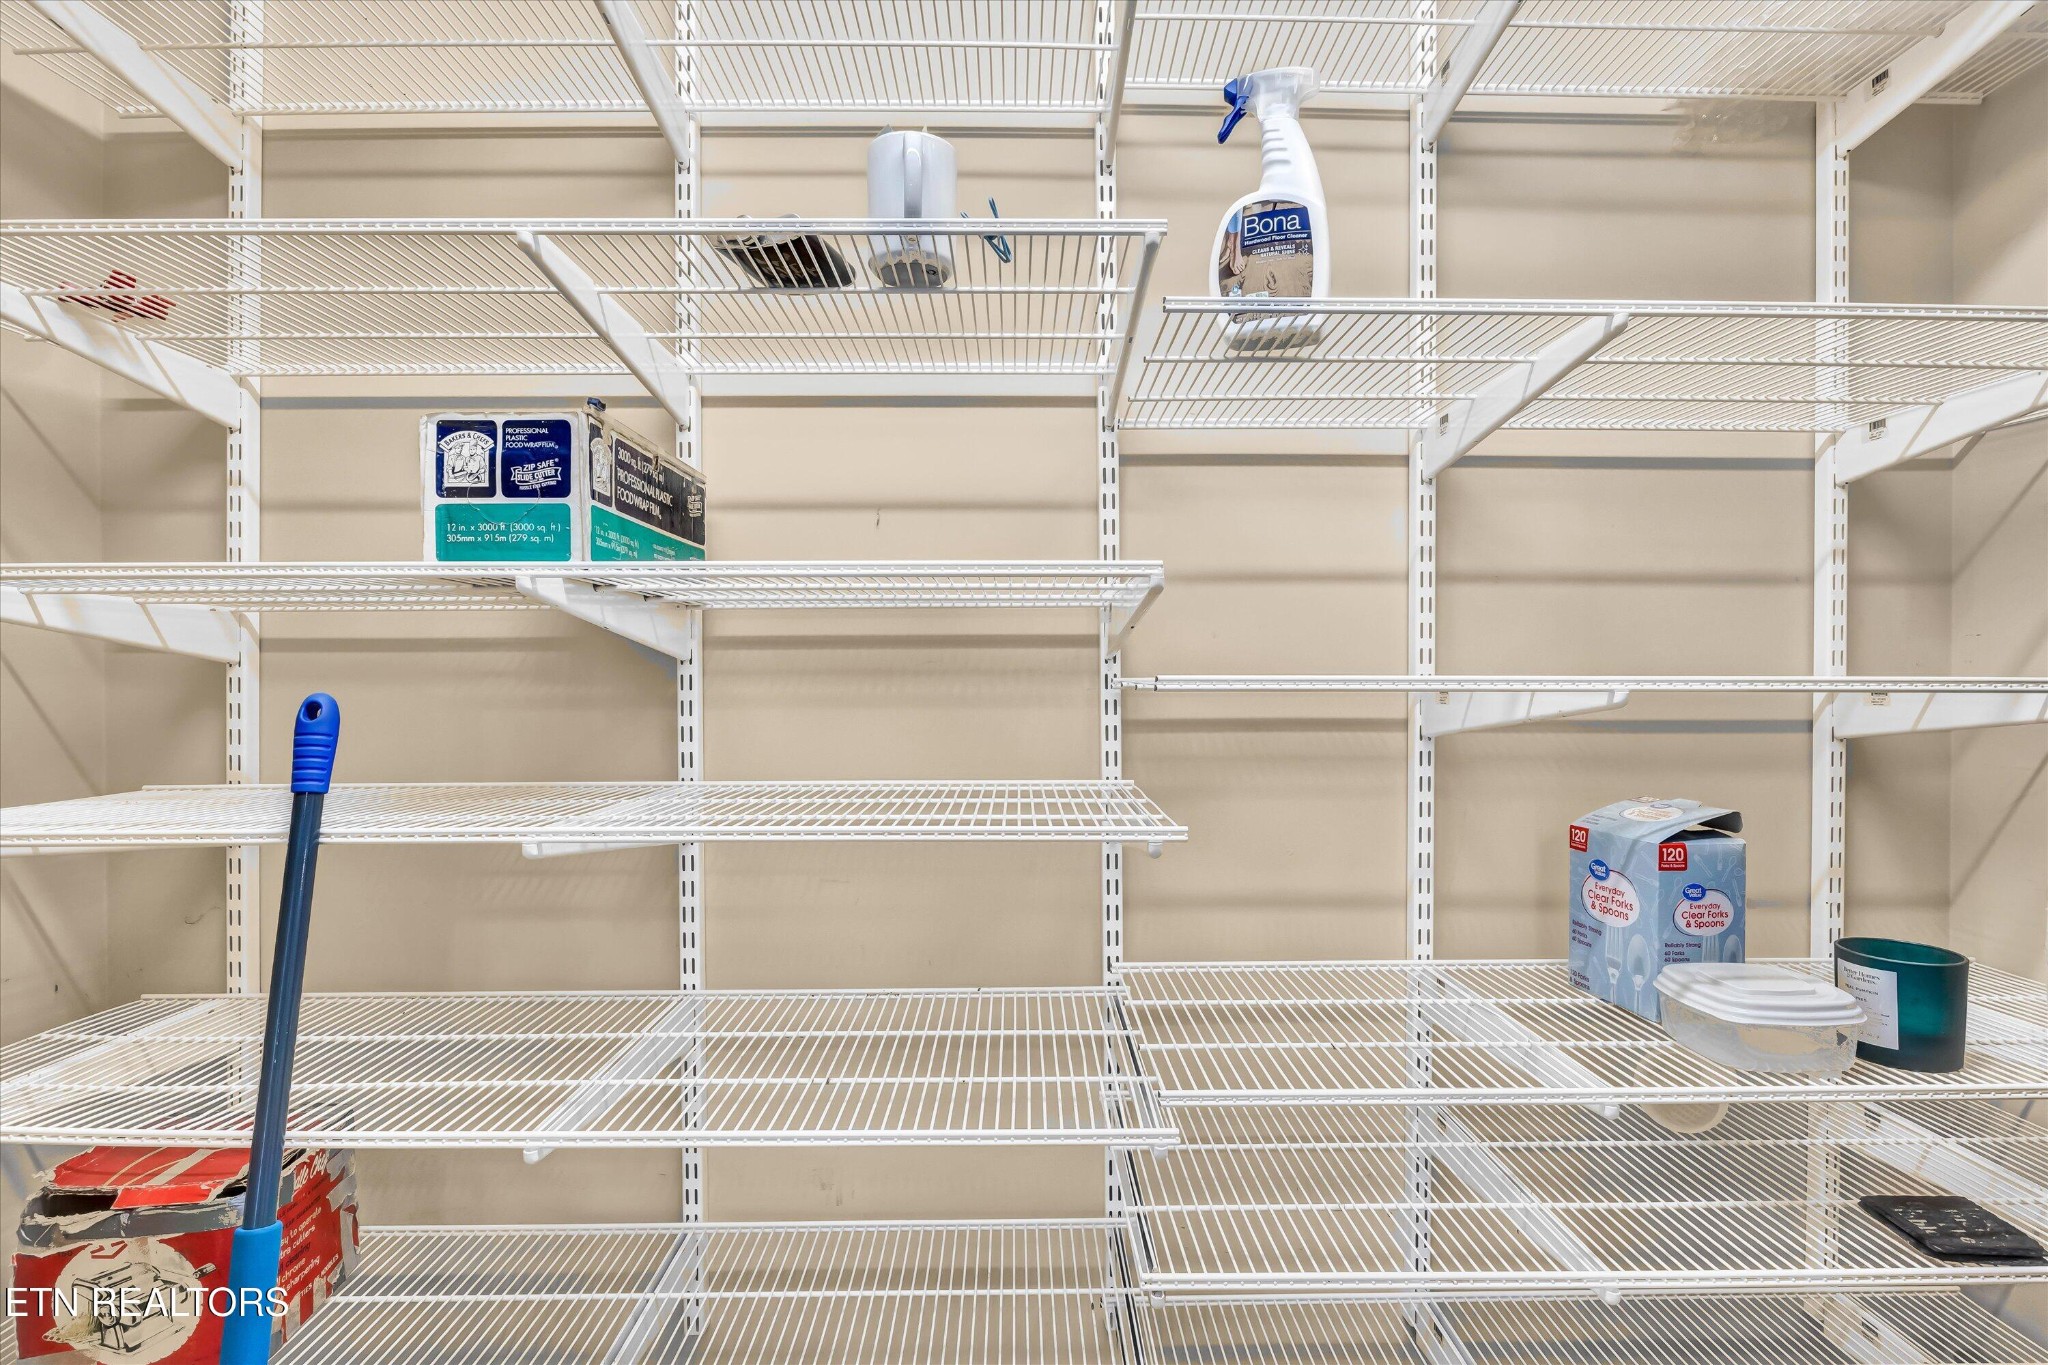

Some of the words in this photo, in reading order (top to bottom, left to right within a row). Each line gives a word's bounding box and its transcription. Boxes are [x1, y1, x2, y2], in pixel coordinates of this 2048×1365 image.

[1244, 214, 1302, 237] Bona
[1244, 236, 1272, 246] Hardwood
[1252, 247, 1270, 255] CLEANS
[444, 432, 466, 446] BAKERS
[617, 447, 631, 463] 3000
[523, 463, 535, 471] ZIP
[537, 460, 555, 469] SAFE
[534, 469, 555, 479] CUTTER
[616, 466, 656, 498] PROFESSIONAL
[655, 488, 673, 507] PLASTIC
[616, 486, 634, 505] FOOD
[634, 494, 649, 511] WRAP
[649, 502, 660, 517] FILM
[446, 524, 456, 532] 12
[458, 523, 468, 531] in.
[477, 523, 498, 531] 3000
[510, 523, 534, 533] (3000
[536, 525, 547, 533] sq.
[550, 522, 561, 532] ft.)
[446, 534, 474, 543] 305mm
[484, 534, 506, 542] 915m
[509, 533, 528, 543] (279
[544, 534, 554, 543] m)
[1572, 829, 1585, 843] 120
[1662, 848, 1684, 861] 120
[1591, 863, 1606, 873] Great
[1595, 882, 1626, 898] Everyday
[1588, 890, 1609, 903] Clear
[1612, 896, 1633, 911] Forks
[1690, 903, 1721, 911] Everyday
[1591, 901, 1596, 910] &
[1599, 903, 1629, 920] Spoons
[1682, 911, 1705, 920] Clear
[1708, 910, 1728, 919] Forks
[1685, 920, 1692, 928] &
[1694, 919, 1725, 929] Spoons
[1859, 971, 1880, 980] Homes
[280, 1237, 289, 1246] sy
[290, 1228, 297, 1238] to
[298, 1207, 322, 1230] operate
[280, 1247, 291, 1259] tra
[292, 1225, 316, 1249] cutters
[282, 1257, 306, 1282] chrome
[287, 1255, 321, 1290] sharpening
